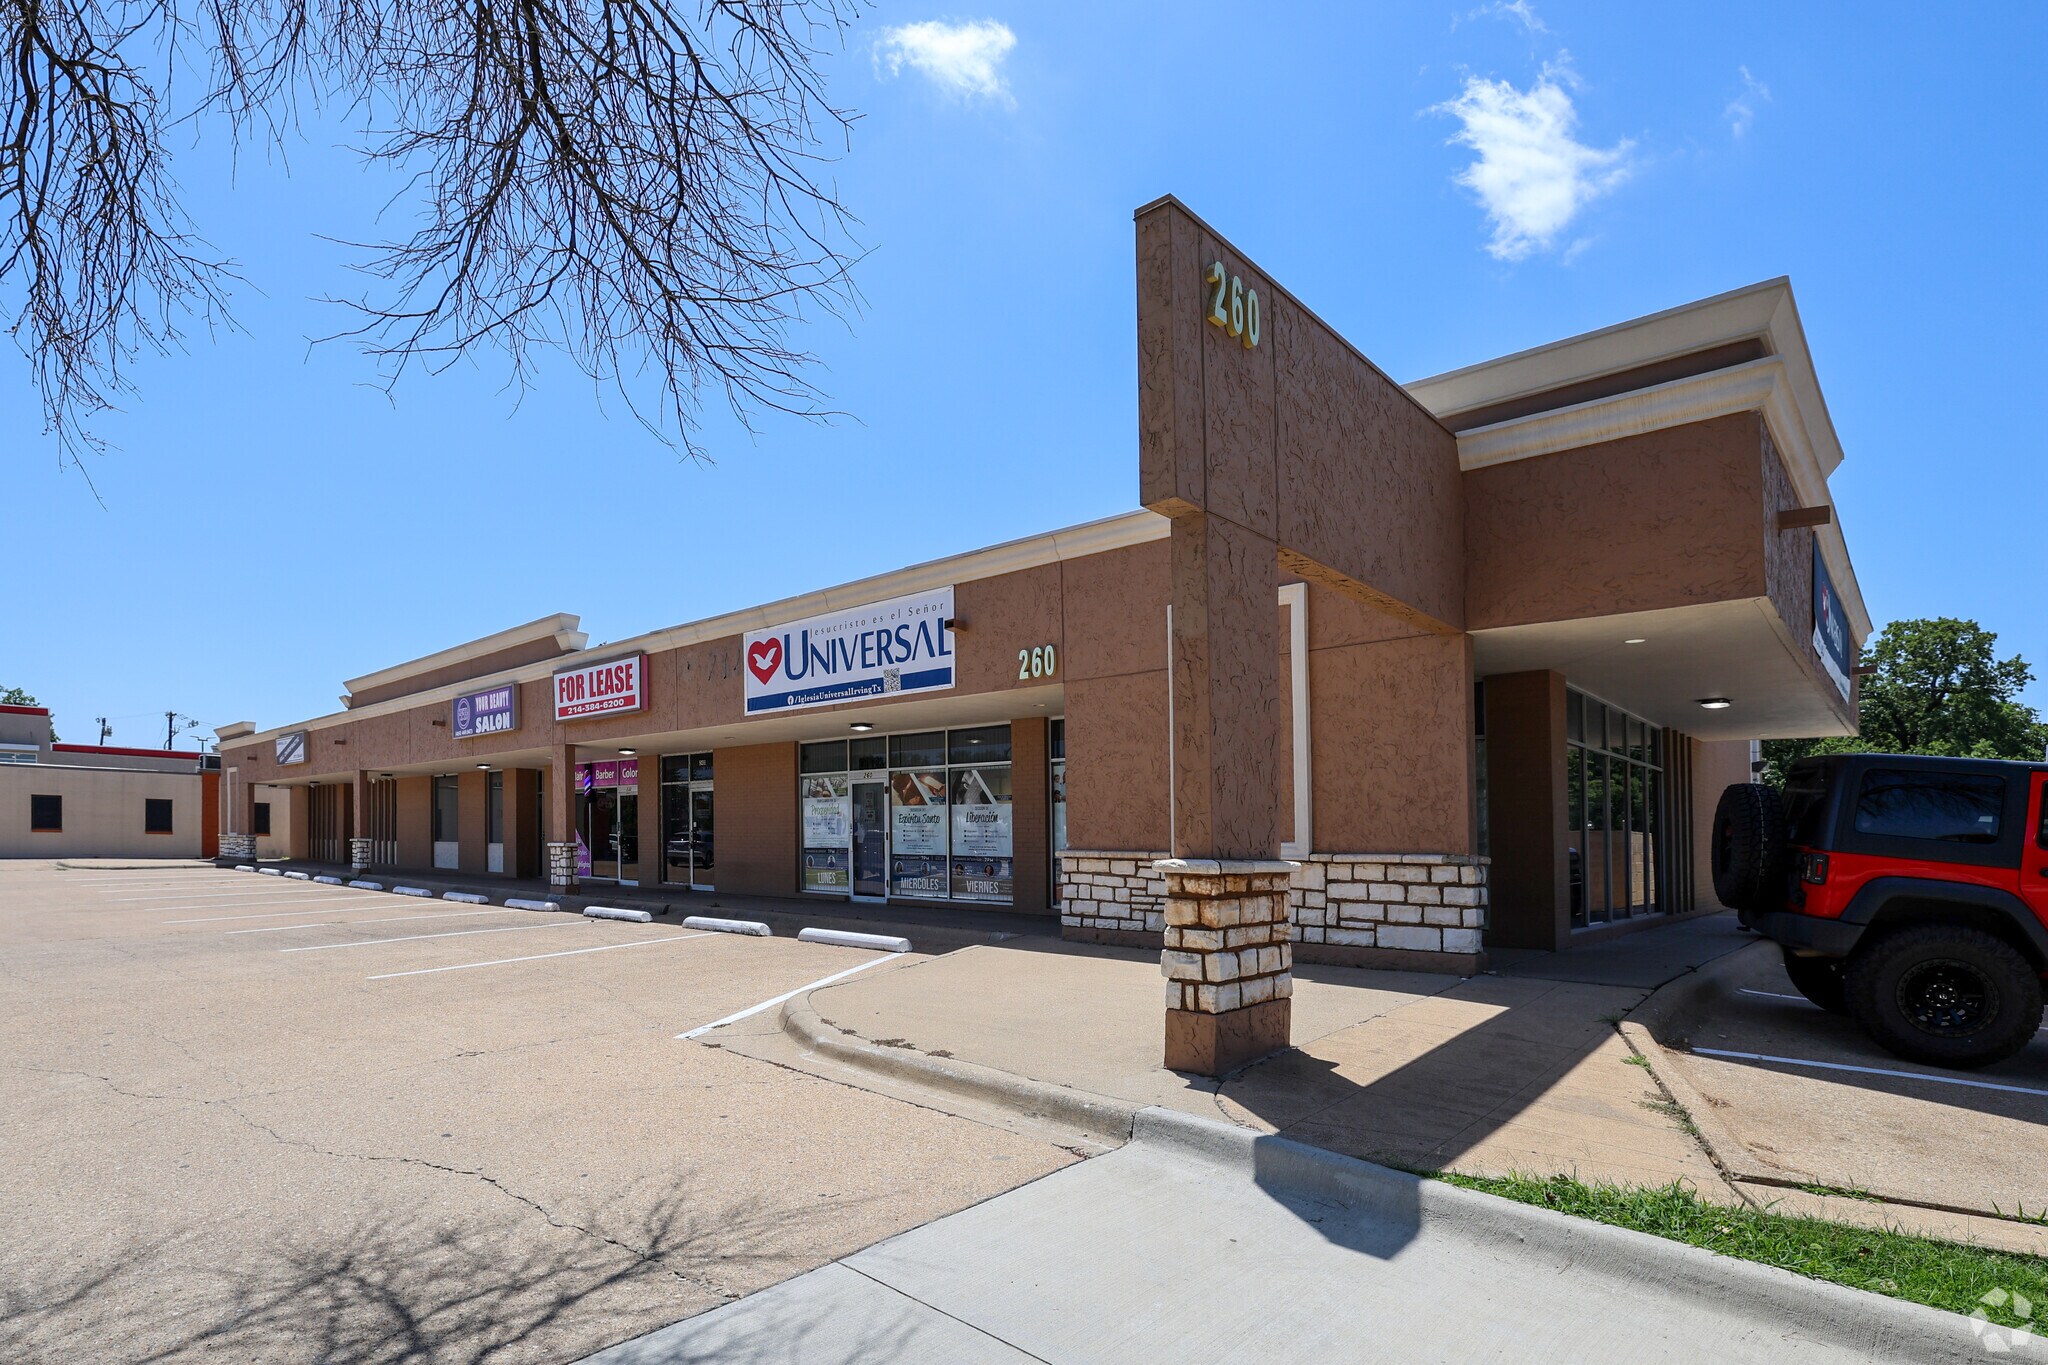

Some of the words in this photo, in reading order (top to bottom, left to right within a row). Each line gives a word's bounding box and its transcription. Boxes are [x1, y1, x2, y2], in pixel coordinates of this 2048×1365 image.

[1207, 261, 1260, 349] 260
[809, 619, 866, 639] Jesucristo
[872, 615, 884, 625] es
[890, 608, 901, 621] el
[908, 602, 944, 617] Señor
[783, 617, 952, 681] UNIVERSAL
[1018, 644, 1056, 680] 260
[558, 673, 586, 704] FOR
[588, 662, 634, 699] LEASE
[475, 694, 489, 713] YOUR
[489, 690, 510, 711] BEAUTY
[567, 698, 625, 715] 214-384-6200
[475, 711, 510, 735] SALON
[595, 768, 615, 780] Barber
[621, 767, 638, 779] Color
[921, 813, 941, 824] Santo
[817, 871, 837, 885] LUNES
[900, 876, 939, 890] MIERCOLES
[966, 880, 999, 894] VIERNES
